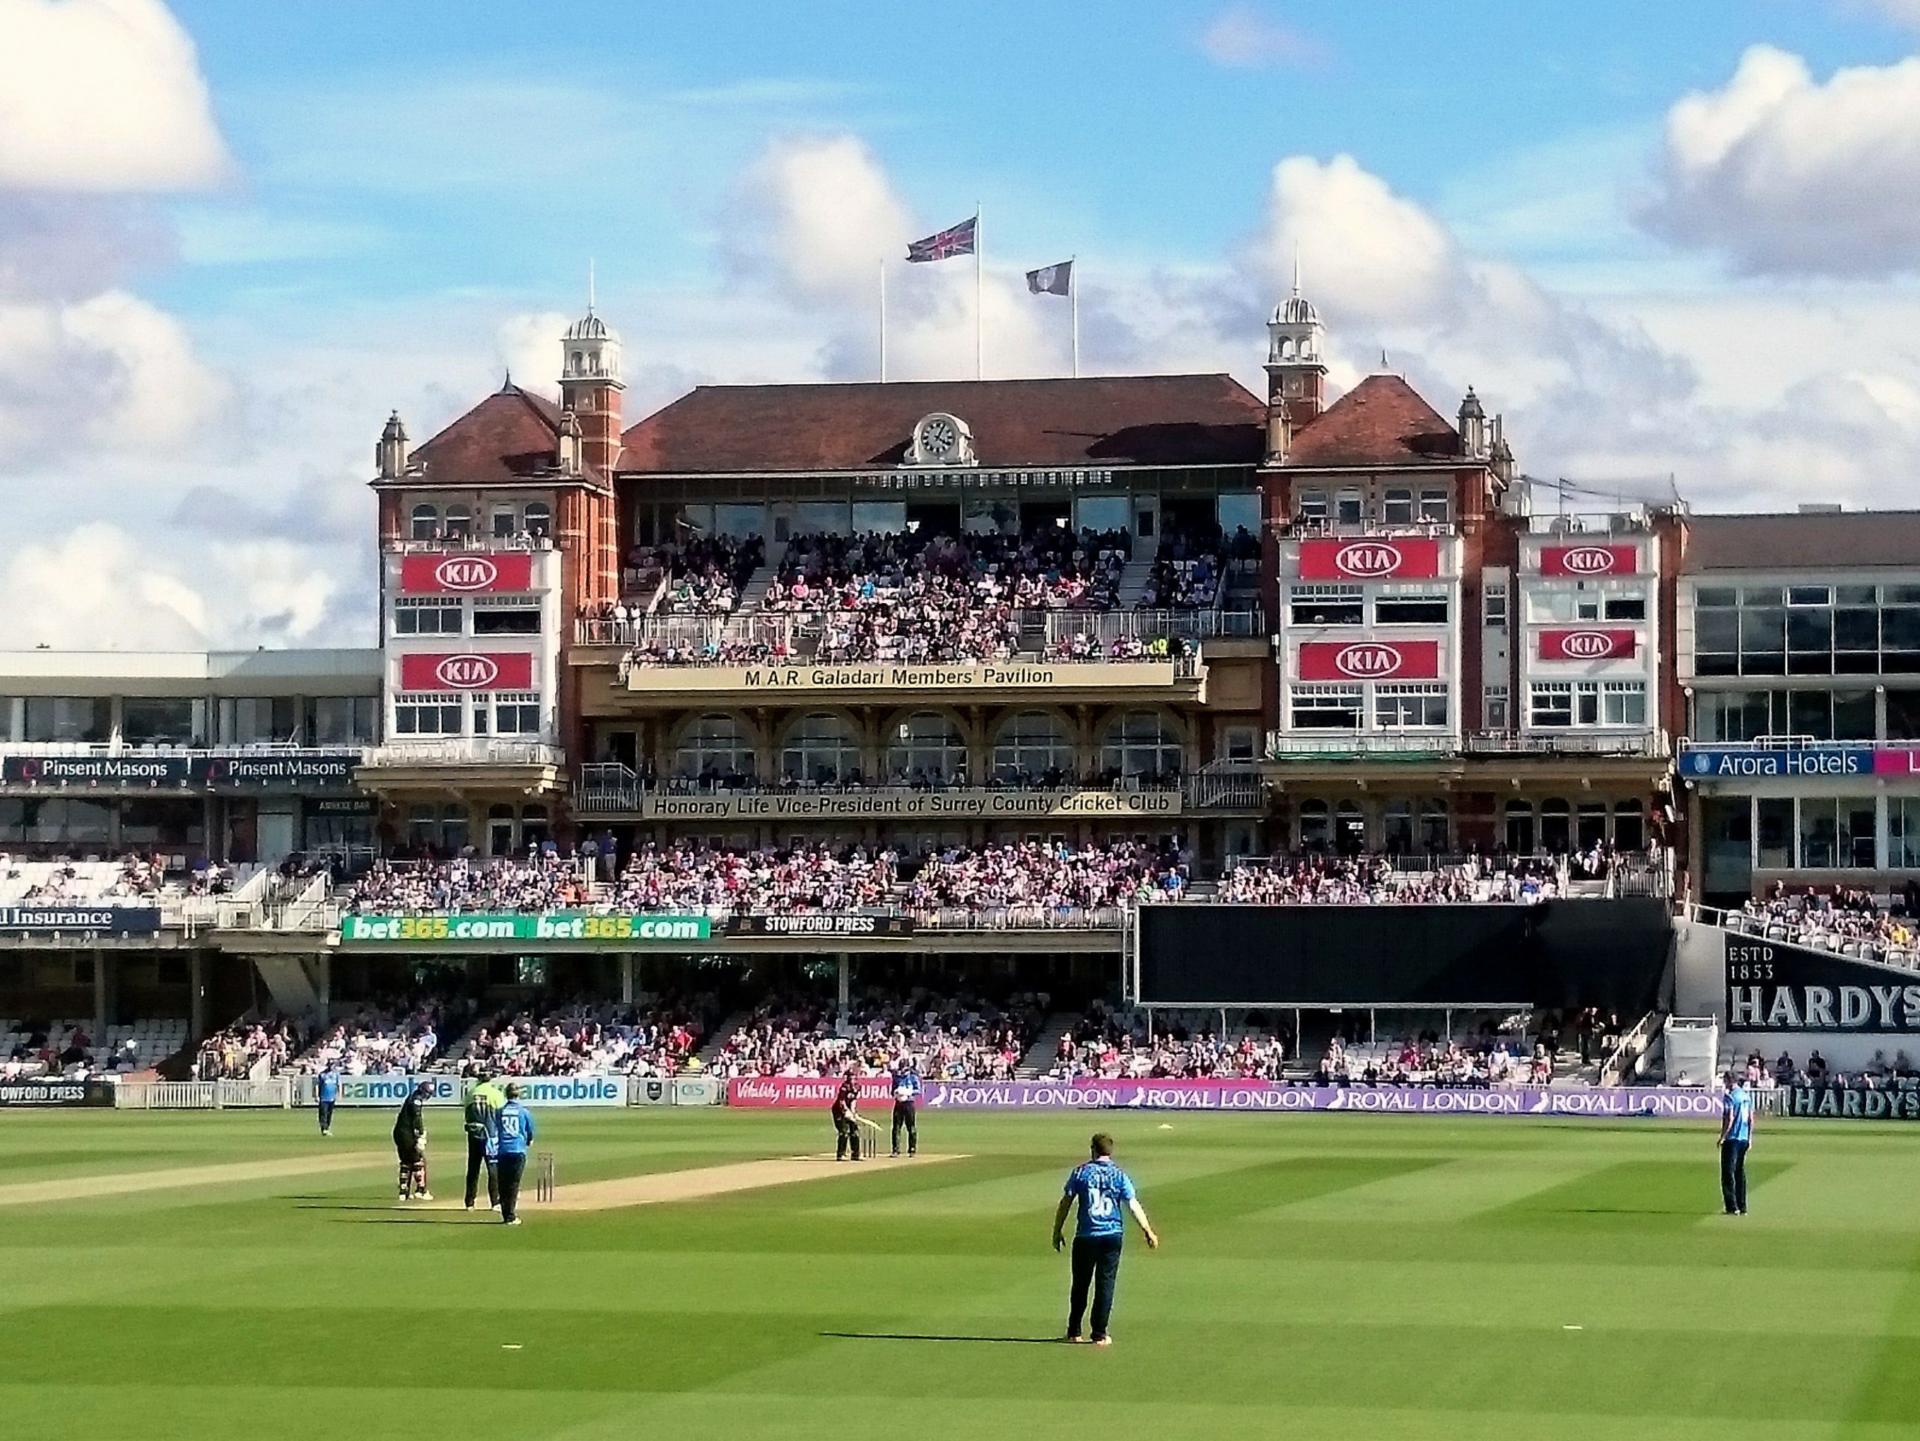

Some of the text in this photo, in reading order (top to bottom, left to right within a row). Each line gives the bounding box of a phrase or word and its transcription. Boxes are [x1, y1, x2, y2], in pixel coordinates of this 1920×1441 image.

[1346, 550, 1391, 569] KIA
[1571, 552, 1605, 568] KIA
[446, 564, 487, 582] KIA
[1570, 637, 1604, 653] KIA
[1346, 651, 1391, 670] KIA
[446, 662, 487, 680] KIA
[812, 669, 884, 685] Galadari
[892, 668, 977, 685] Members'
[983, 667, 1053, 684] Pavilion
[42, 761, 168, 777] Pinsent Masons
[229, 761, 347, 776] Pinsent Masons
[1718, 751, 1858, 775] Arora Hotels
[654, 794, 1170, 816] Honorary Life Vice-President of Surrey County Cricket Club
[12, 908, 113, 925] Insurance
[765, 916, 875, 932] STOWFORD PRESS
[353, 917, 515, 939] bet365.com
[536, 917, 699, 939] bet365.com
[1729, 946, 1774, 962] ESTD
[1730, 963, 1774, 979] 1853
[1730, 984, 1920, 1027] HARDYS
[0, 1085, 85, 1100] OWFORD PRESS
[736, 1079, 781, 1104] Vitality
[784, 1084, 836, 1100] HEALTH
[948, 1087, 1118, 1106] ROYAL LONDON
[1147, 1089, 1316, 1108] ROYAL LONDON
[1349, 1091, 1521, 1111] ROYAL LONDON
[1551, 1092, 1623, 1112] ROYAL
[1794, 1087, 1920, 1117] HARDYS
